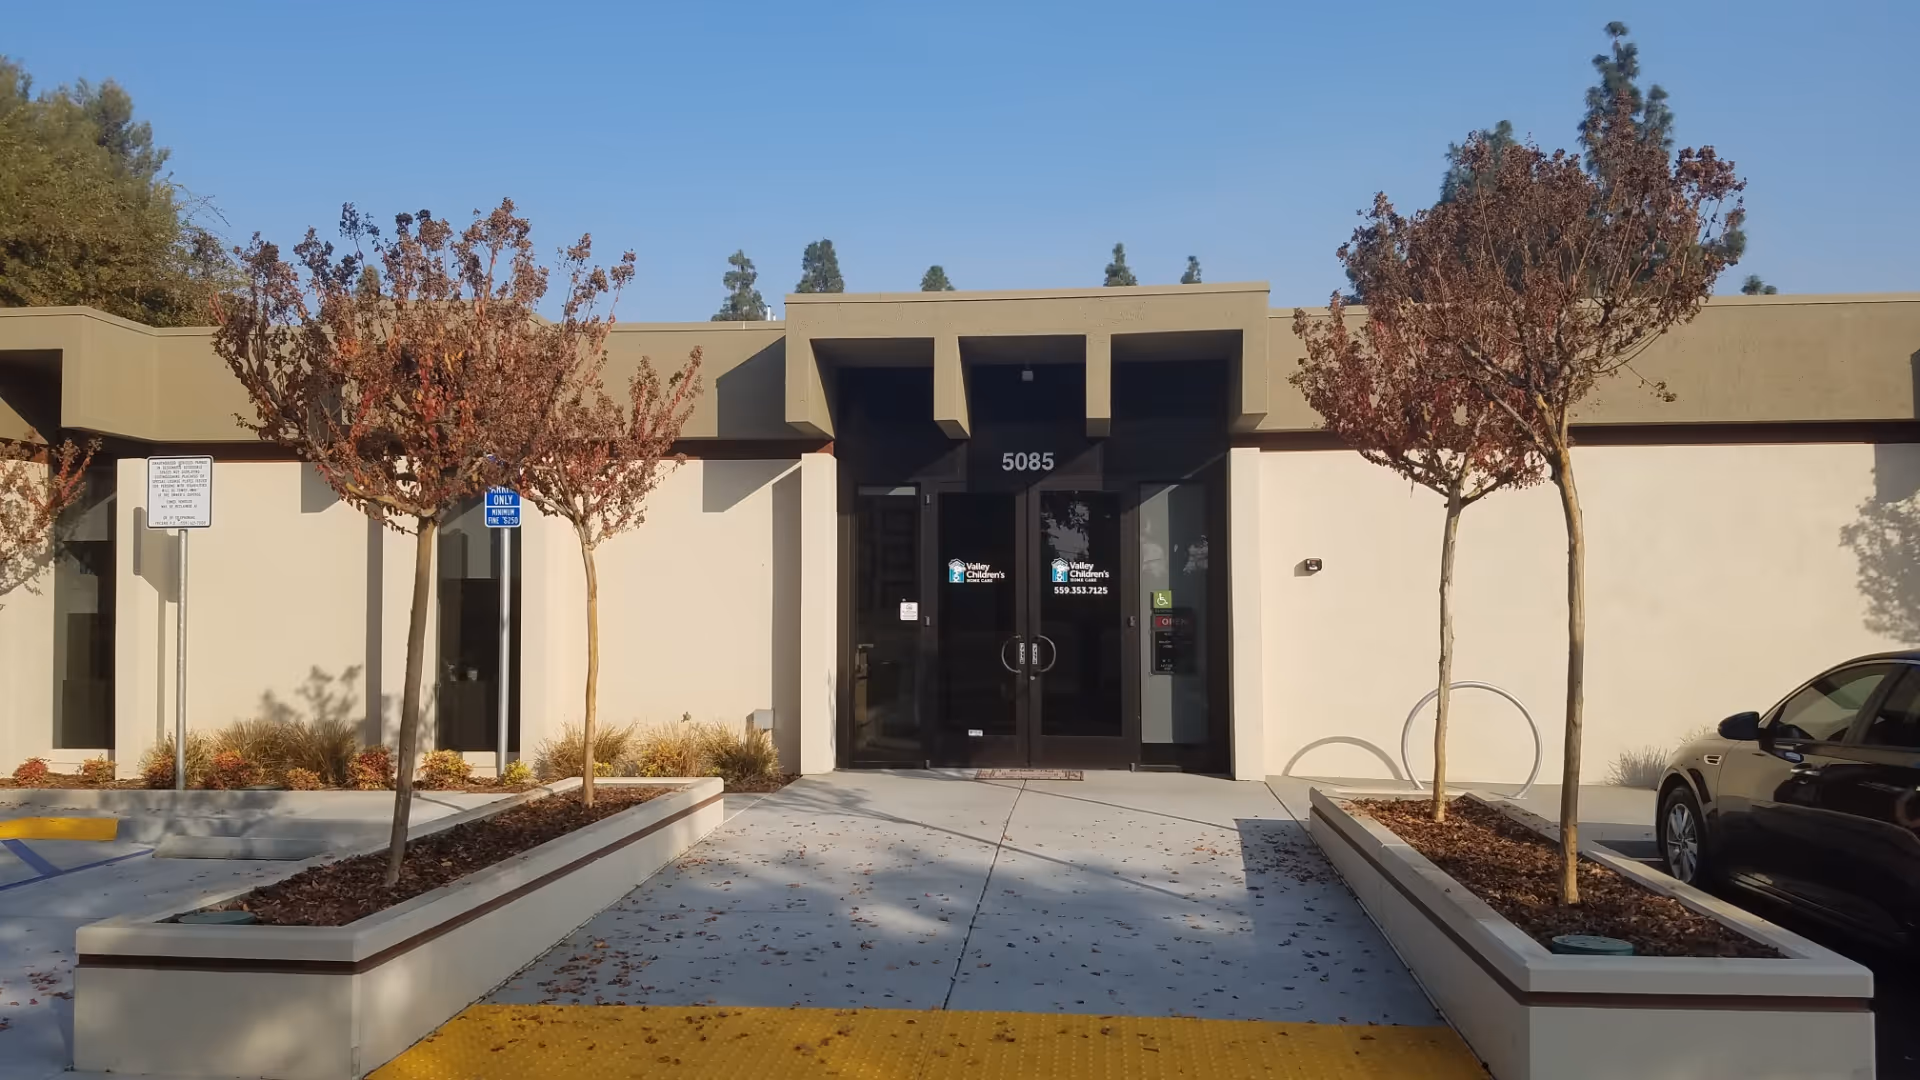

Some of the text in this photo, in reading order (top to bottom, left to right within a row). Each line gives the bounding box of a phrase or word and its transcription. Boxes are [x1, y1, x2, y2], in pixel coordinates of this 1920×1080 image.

[1002, 452, 1055, 471] 5085
[493, 494, 513, 505] ONLY
[491, 508, 515, 516] MINIMUM
[488, 516, 500, 525] FINE
[966, 562, 990, 571] Valley
[1070, 561, 1094, 571] Valley
[966, 570, 1006, 579] Children's
[1070, 569, 1110, 578] Children's
[1054, 586, 1109, 595] 559.353.7125
